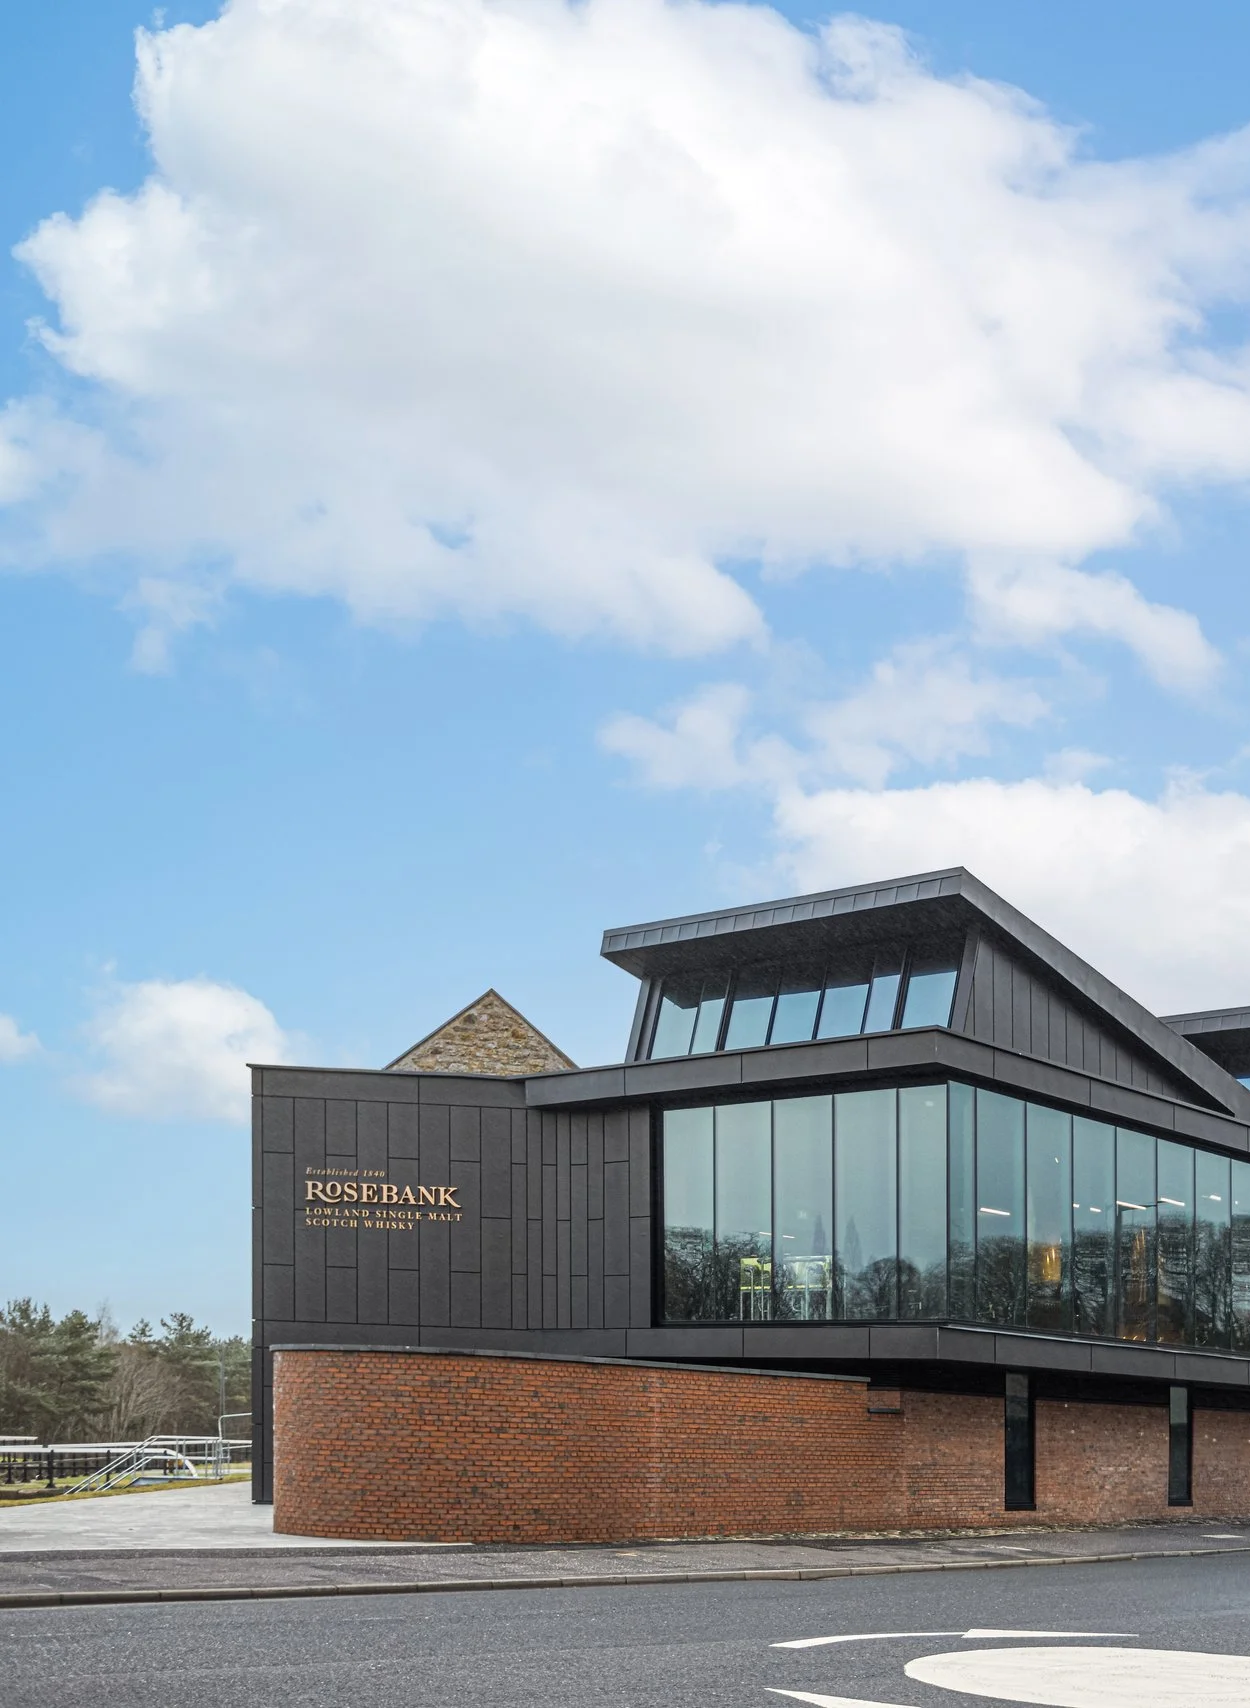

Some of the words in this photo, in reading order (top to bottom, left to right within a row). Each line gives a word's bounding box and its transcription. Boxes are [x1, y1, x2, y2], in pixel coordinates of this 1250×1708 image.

[306, 1167, 358, 1177] Established
[363, 1169, 385, 1178] 1840
[305, 1180, 461, 1208] ROSEBANK
[306, 1207, 370, 1218] LOWLAND
[375, 1210, 423, 1220] SINGLE
[428, 1212, 463, 1222] MALT
[305, 1217, 358, 1228] SCOTCH
[364, 1220, 415, 1230] WHISKY
